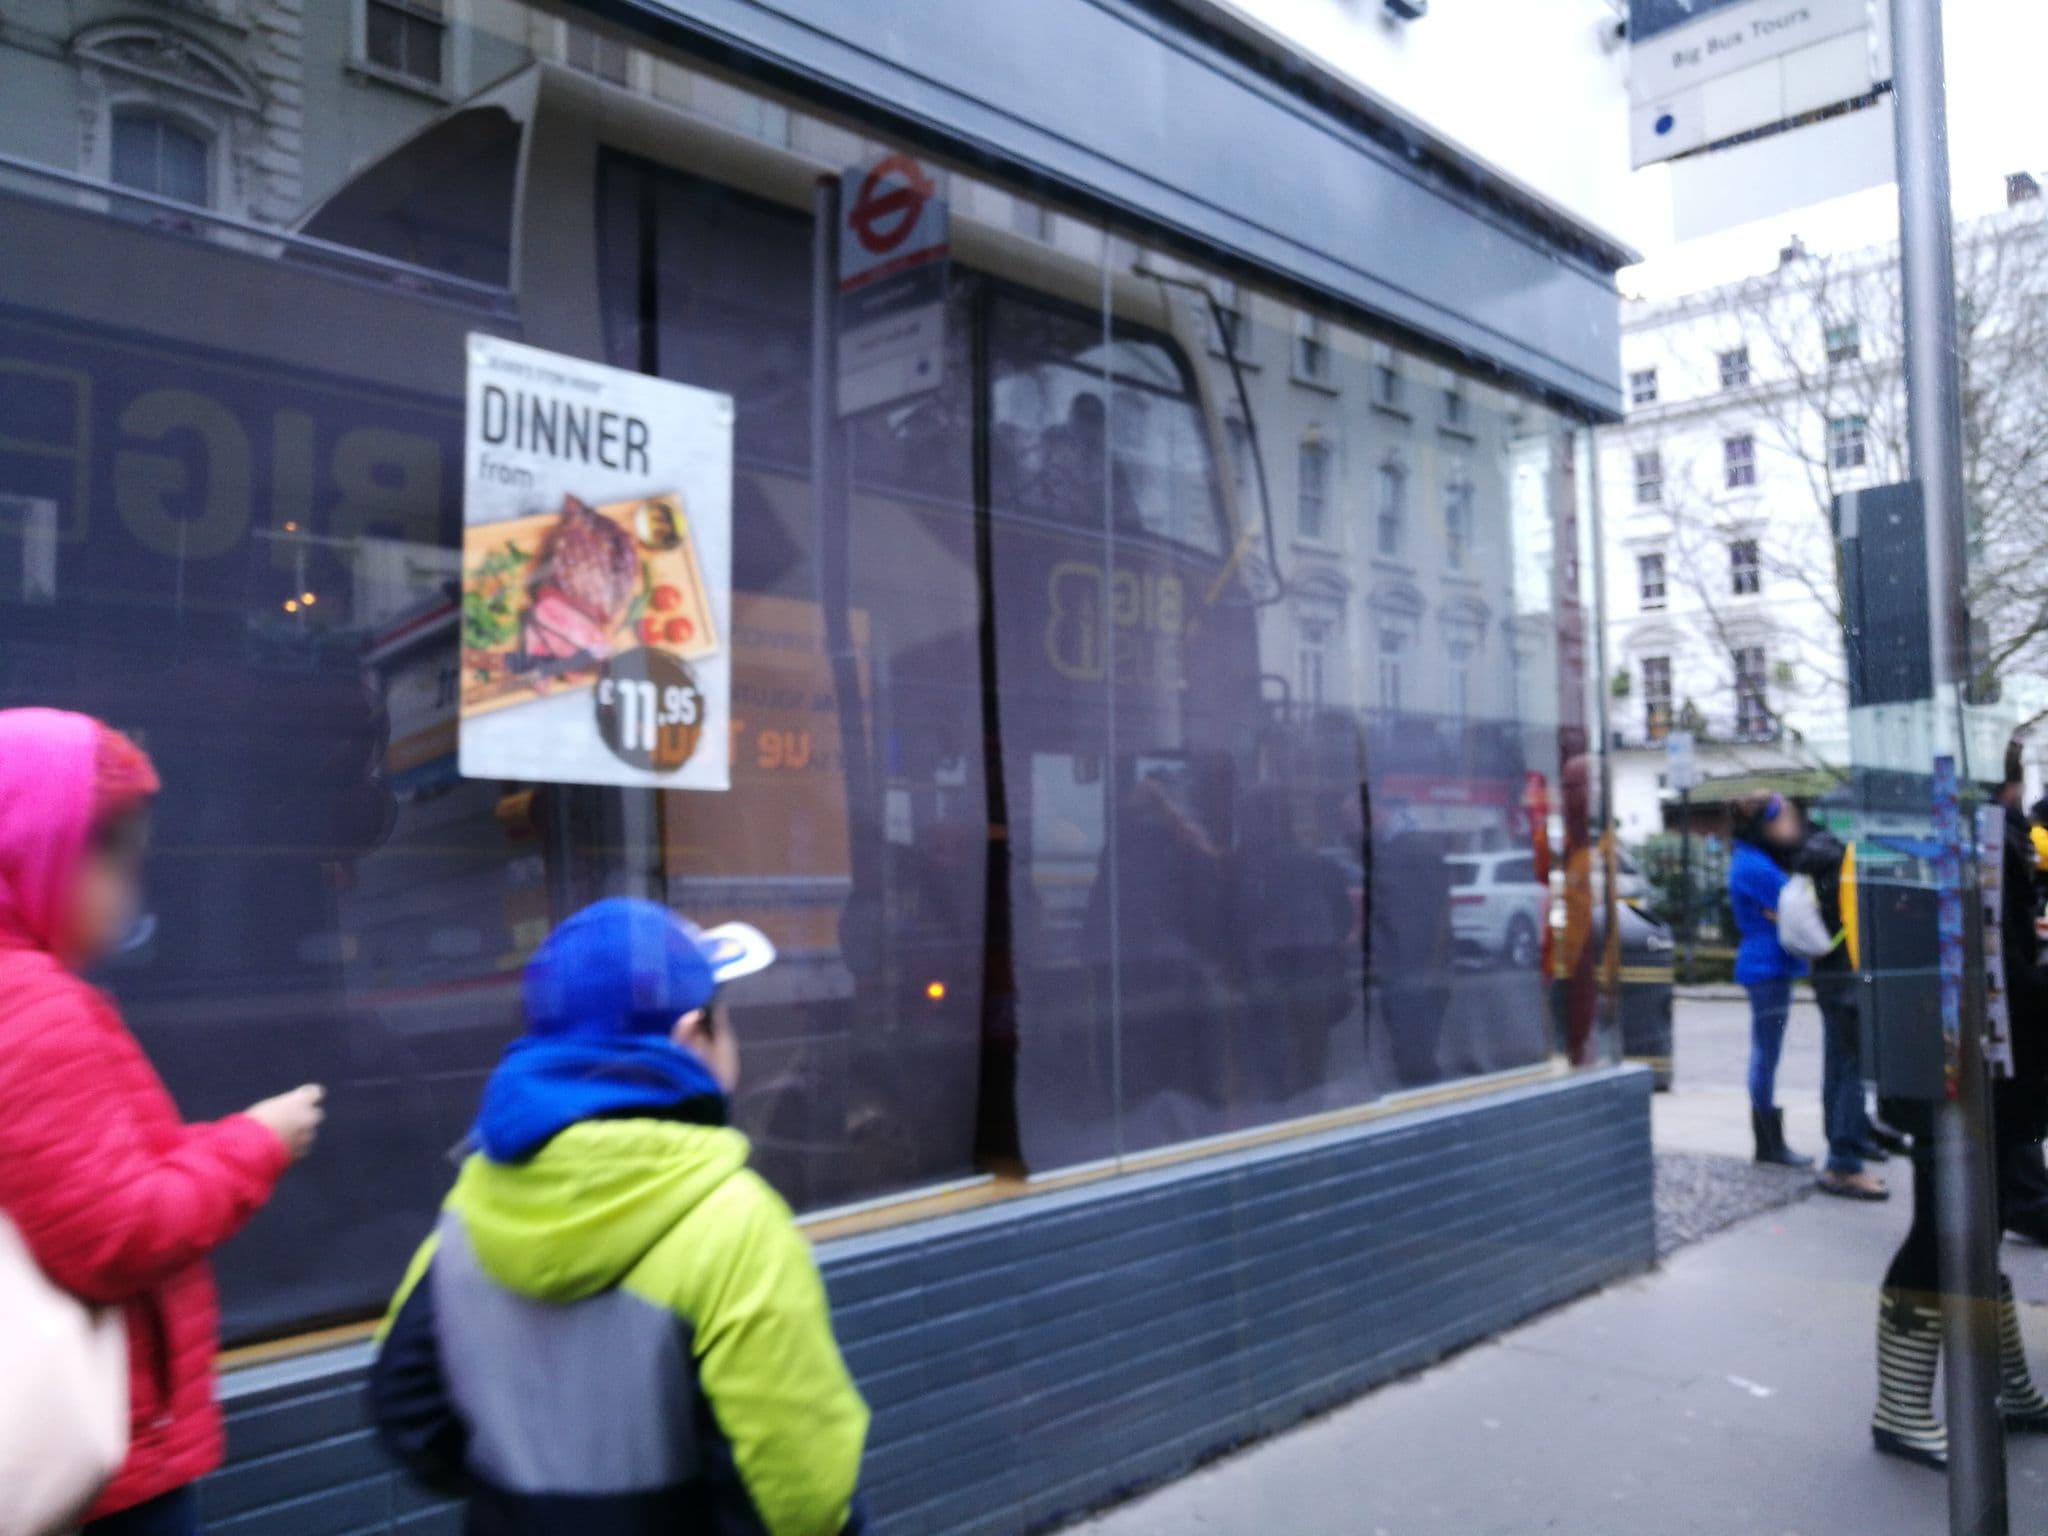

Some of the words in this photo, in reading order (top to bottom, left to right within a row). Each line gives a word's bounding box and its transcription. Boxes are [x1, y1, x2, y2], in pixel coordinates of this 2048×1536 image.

[1706, 31, 1744, 57] Bus
[1750, 8, 1810, 38] Tours
[481, 383, 650, 476] DINNER
[479, 452, 533, 488] from
